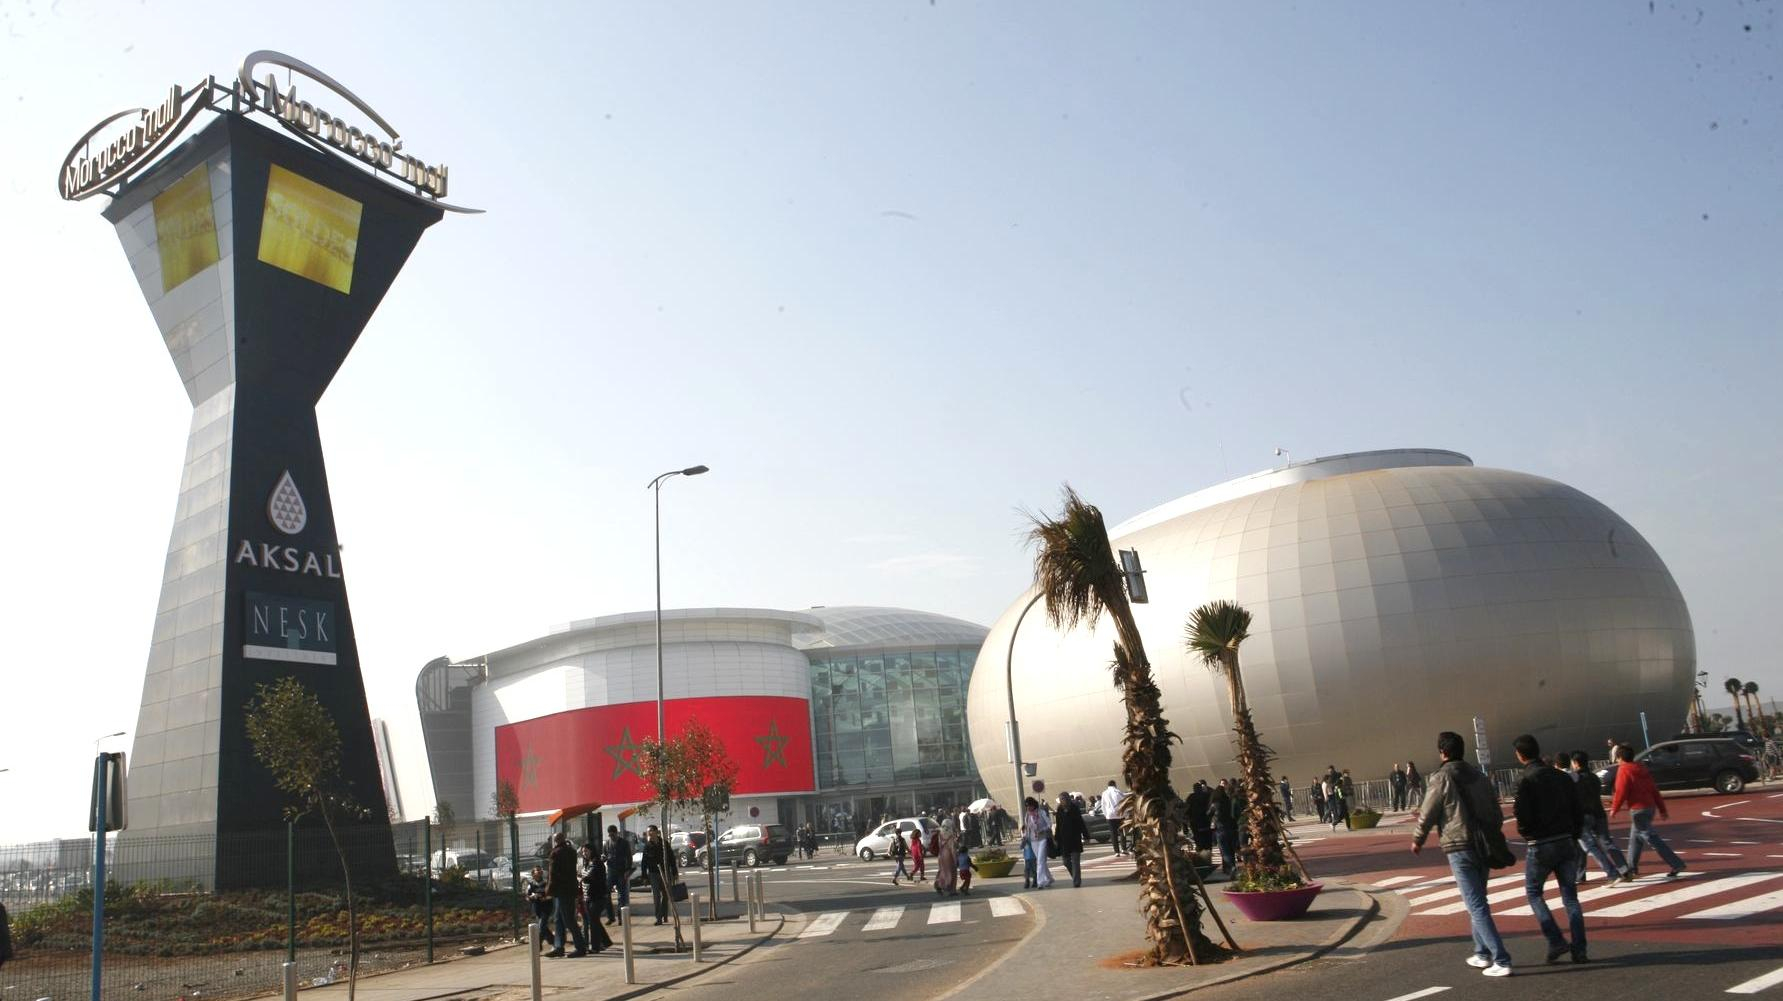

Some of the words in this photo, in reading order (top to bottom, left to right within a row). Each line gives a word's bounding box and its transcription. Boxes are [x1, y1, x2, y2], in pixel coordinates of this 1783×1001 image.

[65, 126, 142, 199] Morocco
[143, 84, 182, 148] mall
[264, 73, 393, 169] Morocco
[401, 154, 448, 197] mall
[236, 540, 341, 578] AKSAL
[254, 604, 328, 641] NESK
